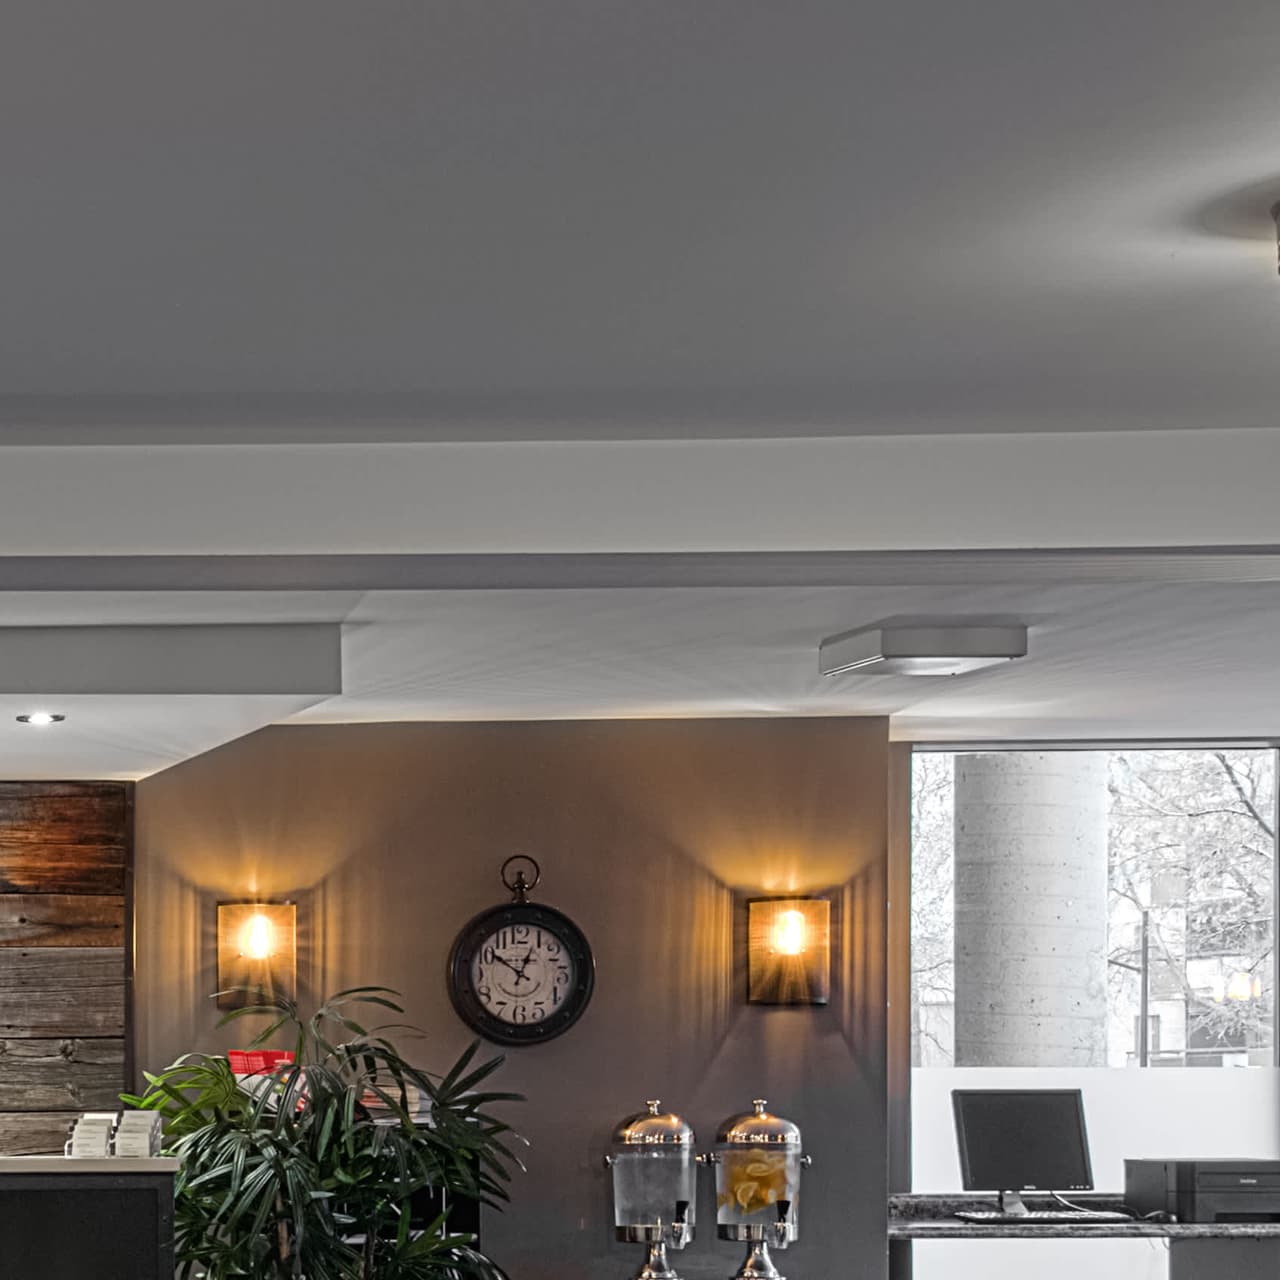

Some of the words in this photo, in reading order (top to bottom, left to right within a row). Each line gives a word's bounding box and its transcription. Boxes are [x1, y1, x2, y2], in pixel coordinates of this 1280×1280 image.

[495, 931, 507, 950] 11
[511, 926, 530, 945] 12
[547, 943, 561, 962] 2
[512, 1005, 527, 1024] 6
